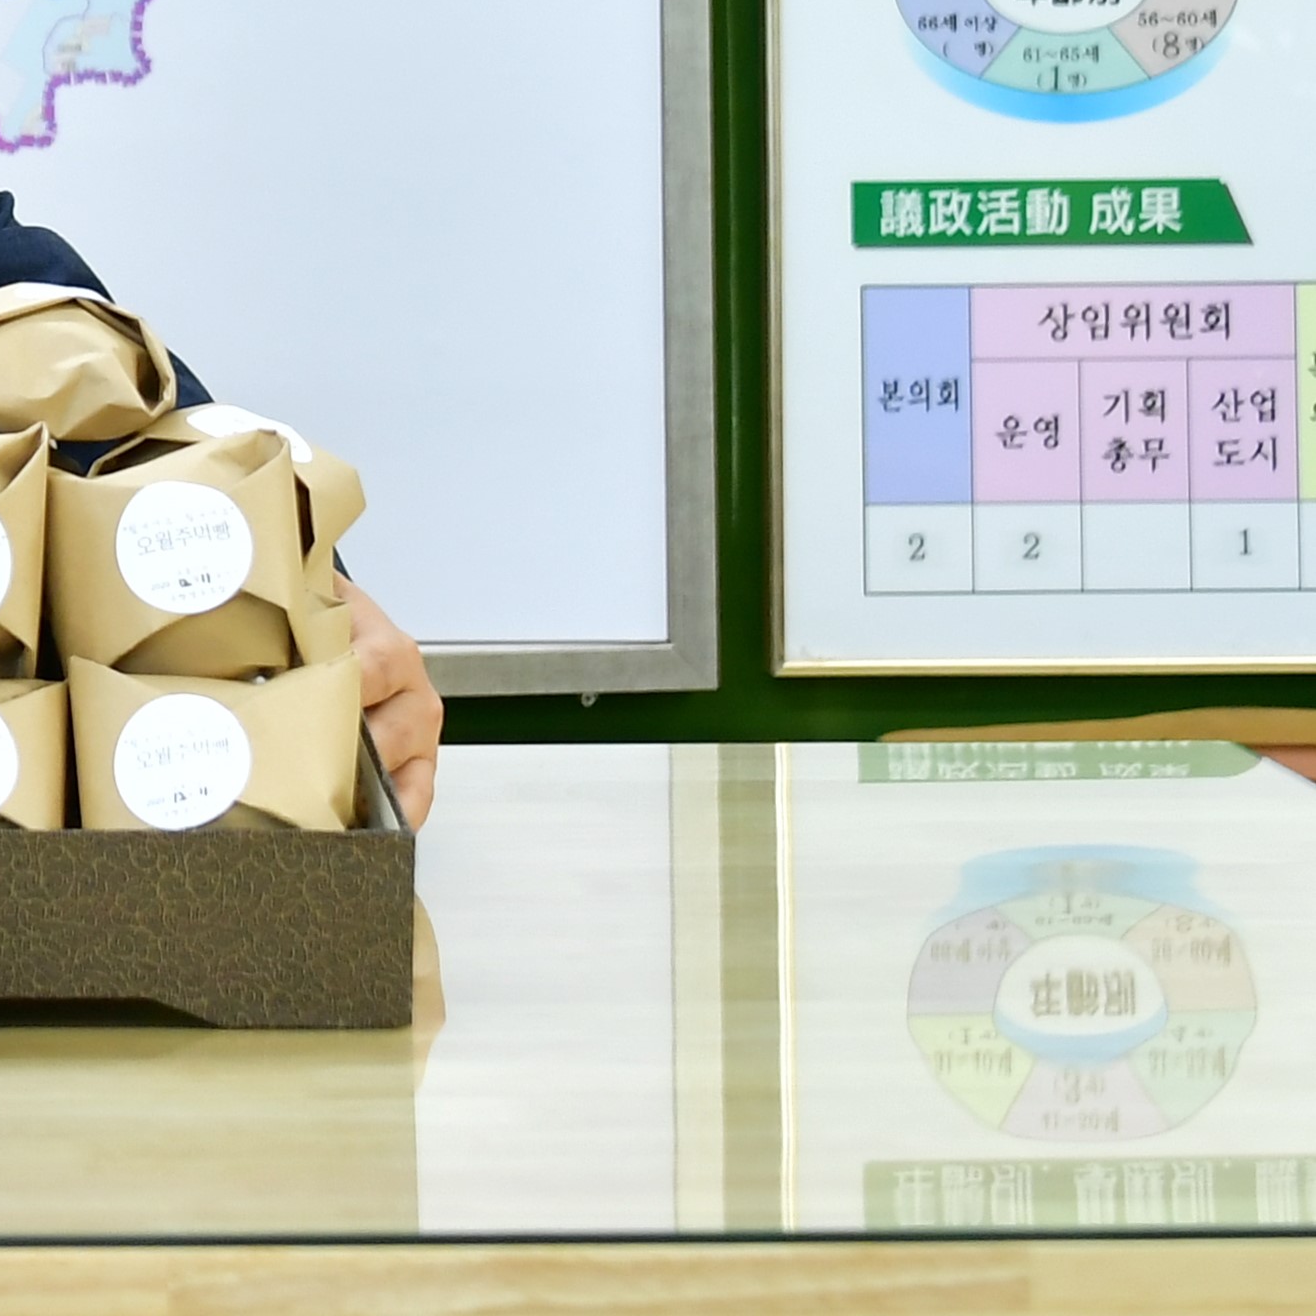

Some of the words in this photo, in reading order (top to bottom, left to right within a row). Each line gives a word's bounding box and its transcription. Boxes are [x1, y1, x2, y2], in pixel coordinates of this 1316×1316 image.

[880, 188, 1069, 238] 議政活動
[1089, 186, 1184, 236] 成果
[1039, 301, 1232, 343] 상임위원회
[878, 377, 961, 415] 본의회
[1103, 387, 1167, 425] 기획
[1211, 387, 1278, 425] 산업
[995, 413, 1062, 451] 운영
[1213, 434, 1279, 472] 도시
[908, 533, 926, 562] 2
[1022, 533, 1041, 560] 2
[1239, 528, 1253, 556] 1
